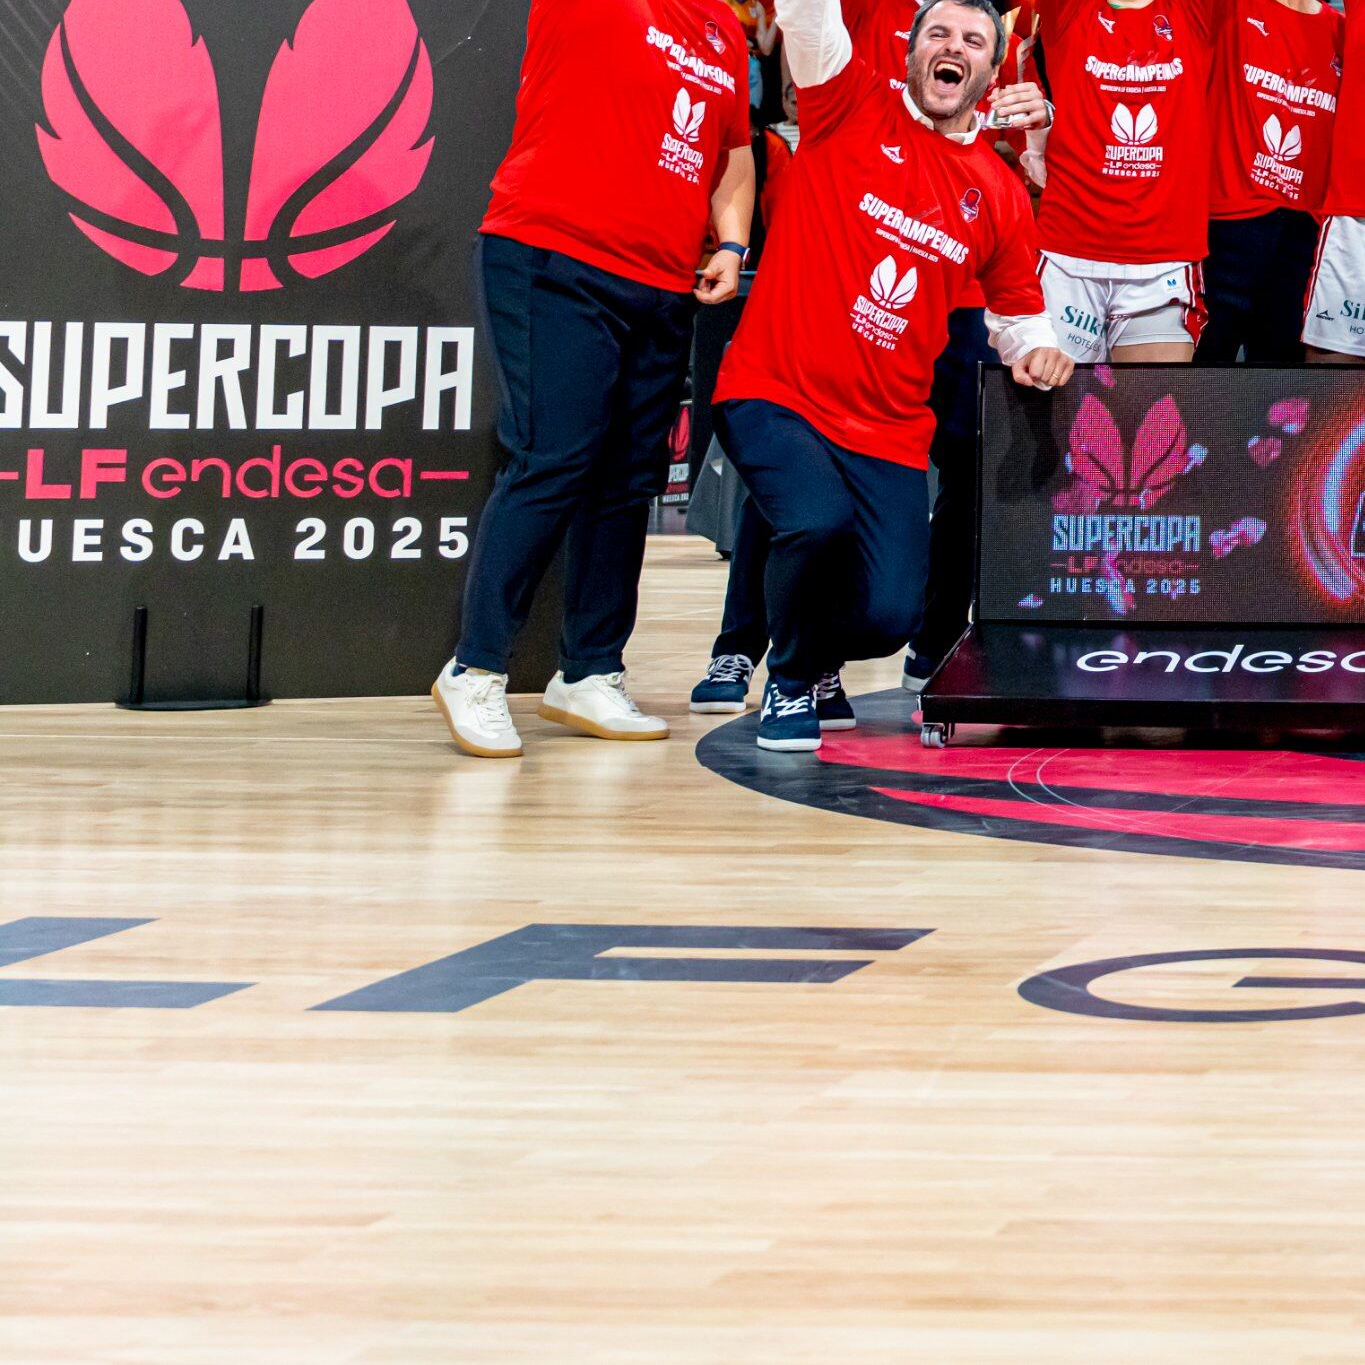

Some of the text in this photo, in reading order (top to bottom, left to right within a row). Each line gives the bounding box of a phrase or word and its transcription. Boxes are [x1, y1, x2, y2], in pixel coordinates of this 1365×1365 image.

[1105, 145, 1163, 161] SUPERCOPA
[853, 294, 908, 334] SUPERCOPA
[1060, 305, 1106, 338] Silk
[25, 445, 413, 499] LF endesa
[293, 516, 470, 561] 2025
[1053, 514, 1200, 551] SUPERCOPA
[1146, 578, 1200, 594] 2025
